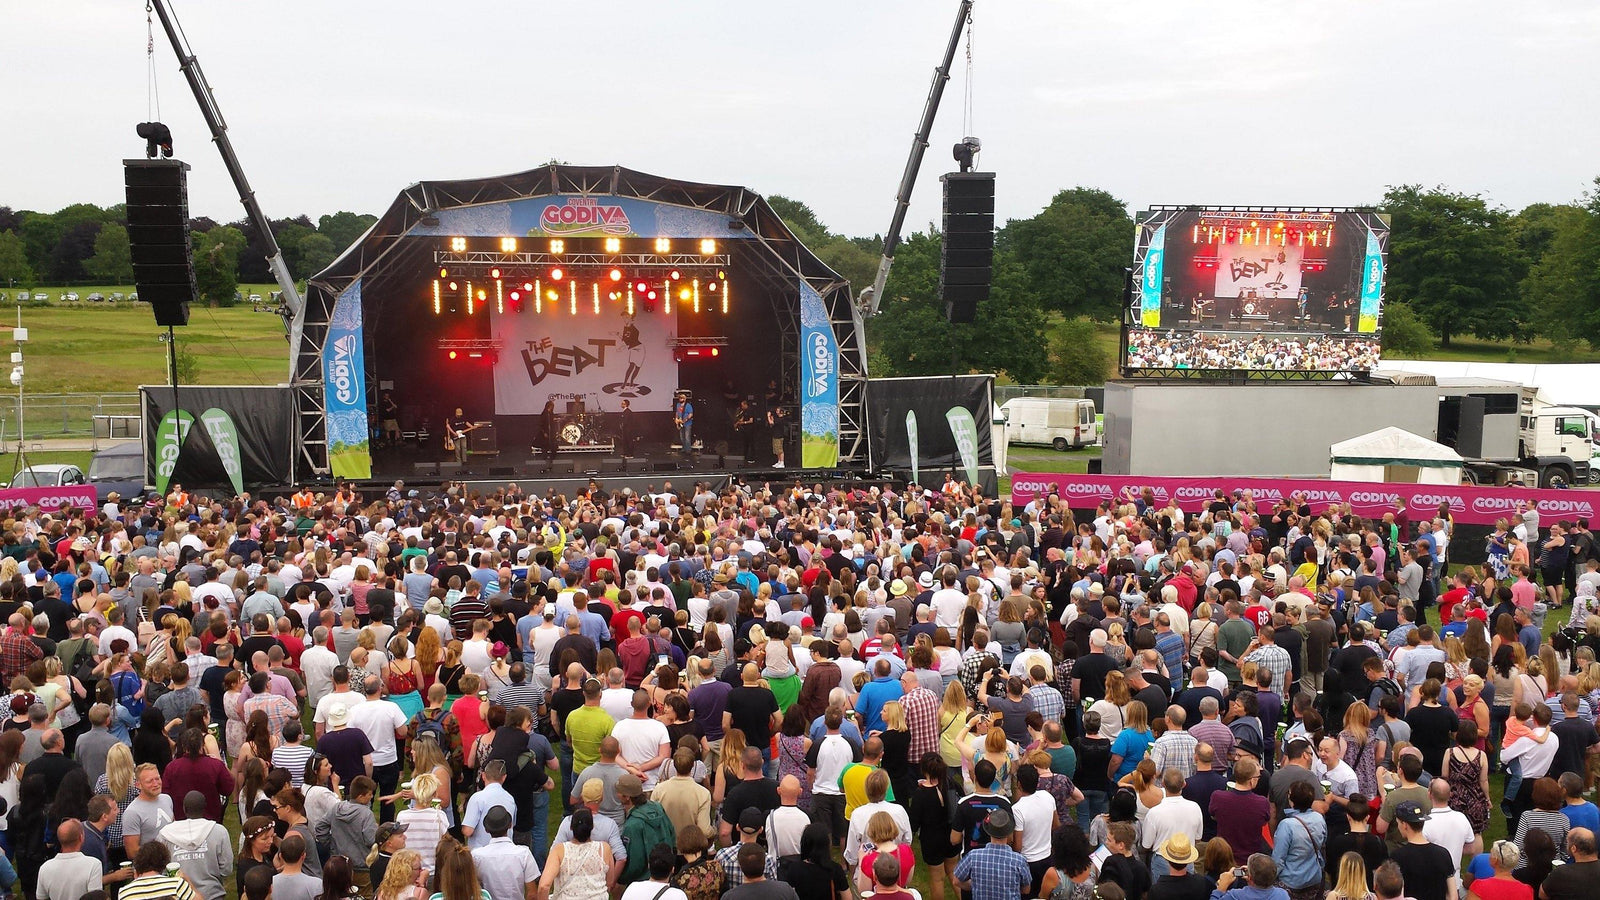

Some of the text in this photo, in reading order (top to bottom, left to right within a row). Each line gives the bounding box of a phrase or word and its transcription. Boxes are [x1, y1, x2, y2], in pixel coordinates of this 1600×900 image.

[568, 198, 597, 206] COVENTRY
[542, 205, 629, 224] GODIVA
[526, 337, 552, 354] THE
[334, 335, 350, 402] GODIVA
[815, 335, 828, 397] GODIVA
[1014, 481, 1055, 492] GODIV
[1068, 483, 1113, 494] GODIVA
[1121, 485, 1168, 497] GOVA
[1177, 487, 1221, 498] GODIV
[1234, 488, 1282, 499] DIVA
[1412, 494, 1465, 506] GODIVA
[1538, 499, 1593, 512] GODIVA
[1257, 610, 1268, 626] 66
